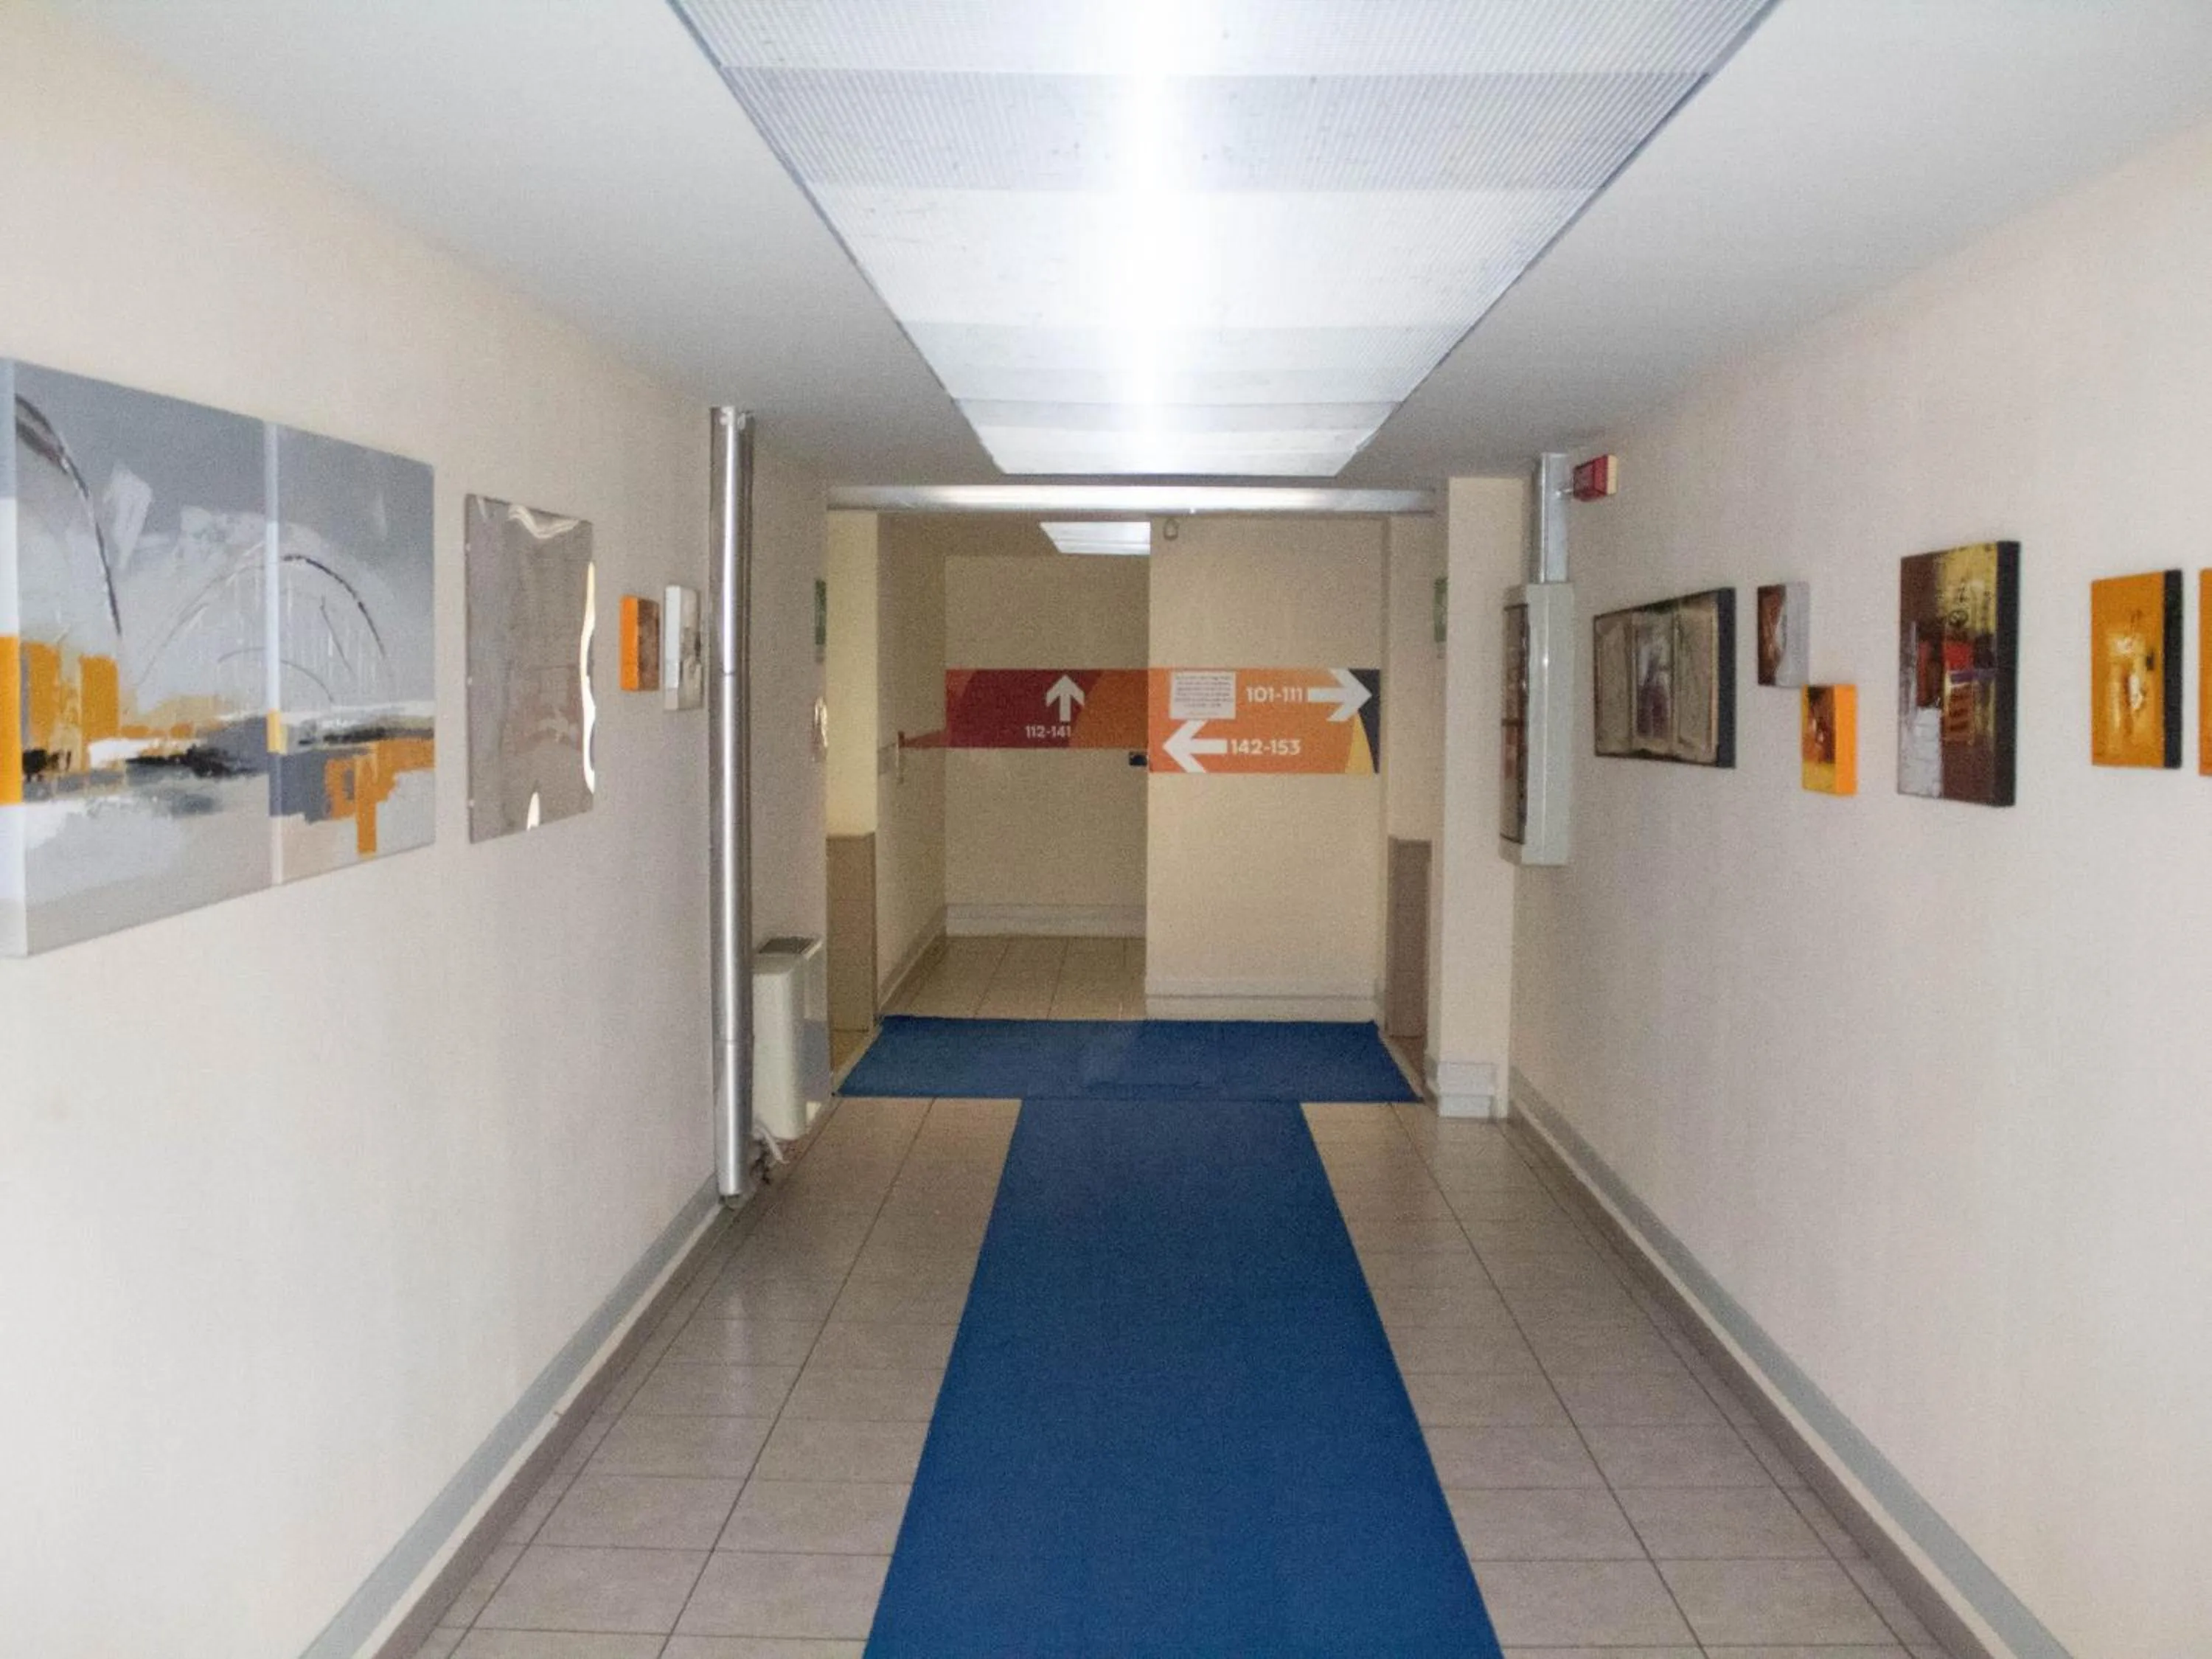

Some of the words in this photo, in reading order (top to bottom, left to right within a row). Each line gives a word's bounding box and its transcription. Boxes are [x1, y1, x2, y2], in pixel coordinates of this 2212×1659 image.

[1246, 686, 1303, 703] 101-111
[1025, 725, 1071, 738] 112-141
[1231, 738, 1301, 755] 142-153
